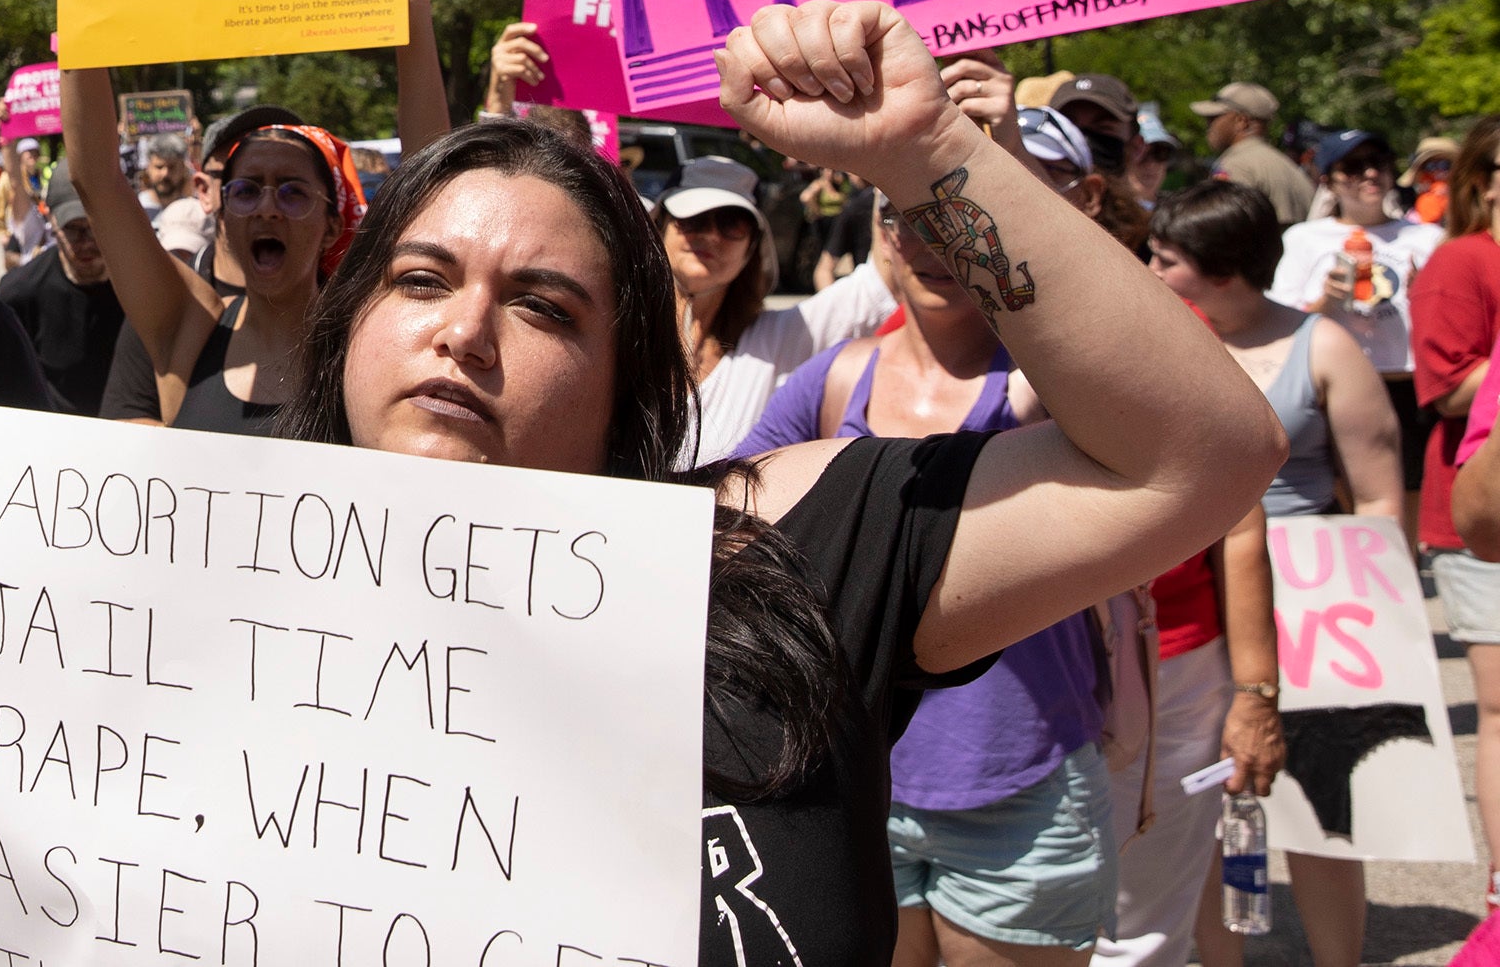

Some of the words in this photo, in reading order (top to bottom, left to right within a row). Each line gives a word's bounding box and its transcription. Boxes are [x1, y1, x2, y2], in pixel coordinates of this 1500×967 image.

[225, 17, 260, 28] liberate
[263, 15, 301, 25] abortion
[305, 13, 335, 22] access
[256, 4, 276, 13] time
[279, 3, 290, 11] to
[292, 2, 309, 12] join
[312, 0, 328, 9] the
[423, 514, 607, 620] GETS
[230, 618, 496, 743] TIME
[243, 750, 519, 881] WHEN
[314, 899, 431, 967] TO
